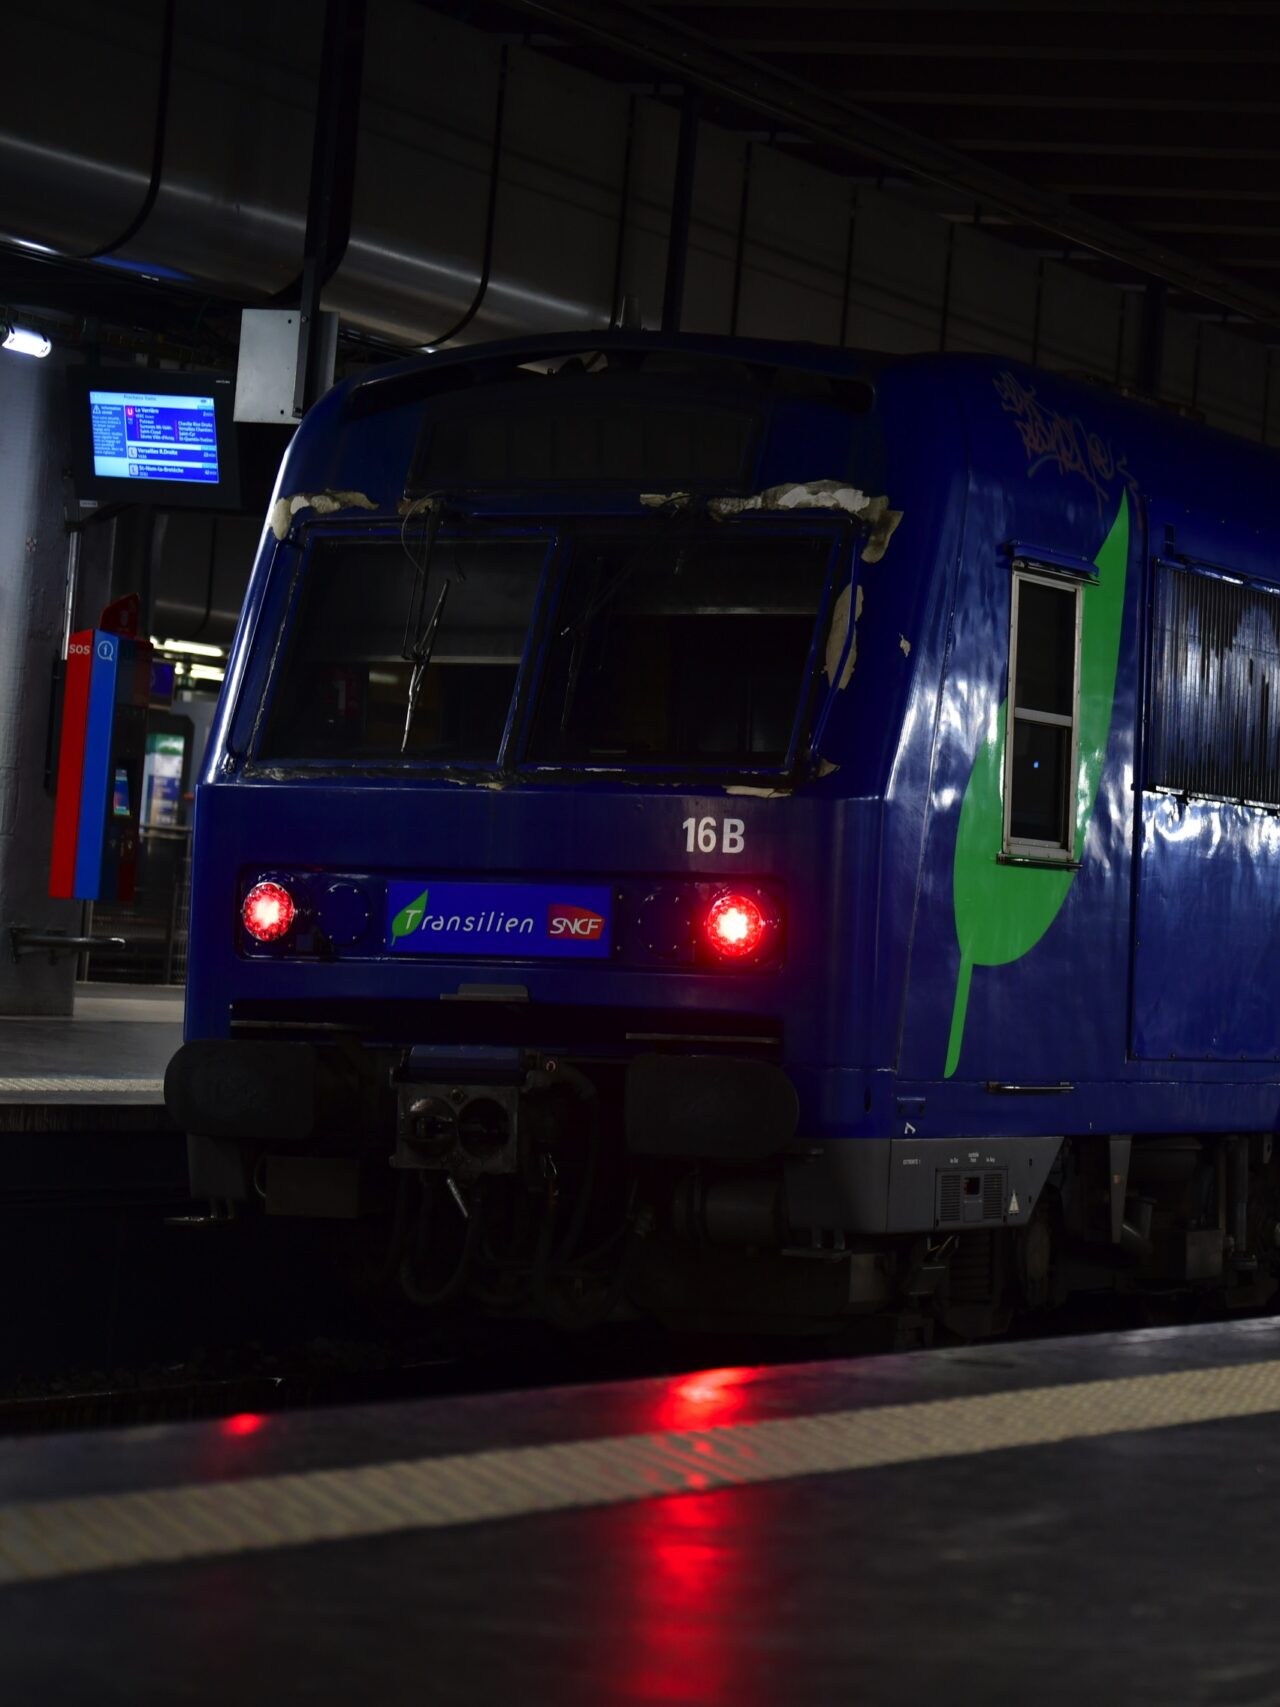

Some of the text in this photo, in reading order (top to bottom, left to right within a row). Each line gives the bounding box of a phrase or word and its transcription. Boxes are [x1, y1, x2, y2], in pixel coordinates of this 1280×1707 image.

[69, 644, 90, 655] SOS
[404, 909, 603, 935] Transilien SNCF
